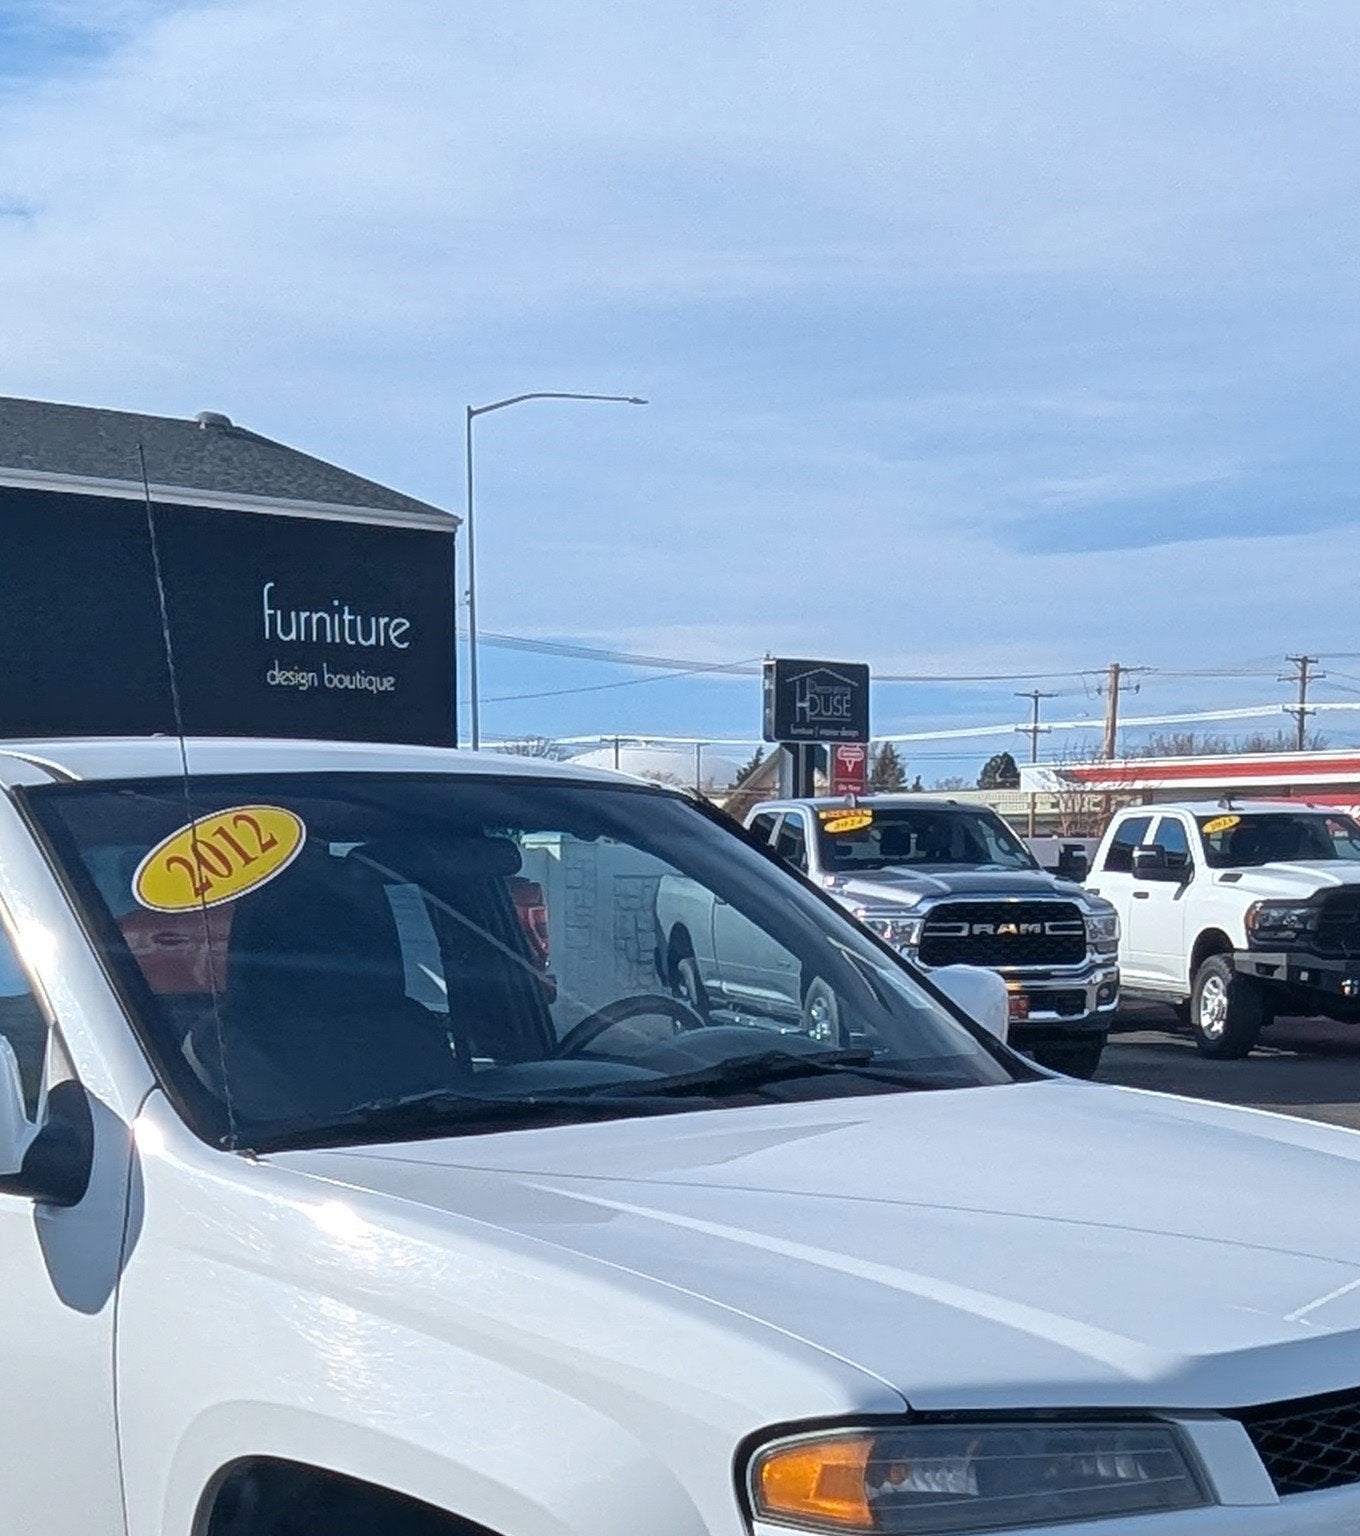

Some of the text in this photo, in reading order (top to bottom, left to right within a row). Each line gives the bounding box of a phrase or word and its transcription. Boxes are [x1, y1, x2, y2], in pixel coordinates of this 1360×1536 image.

[263, 582, 410, 649] furniture
[267, 659, 395, 694] design boutique
[165, 814, 278, 898] 2012
[972, 923, 1041, 935] RAM
